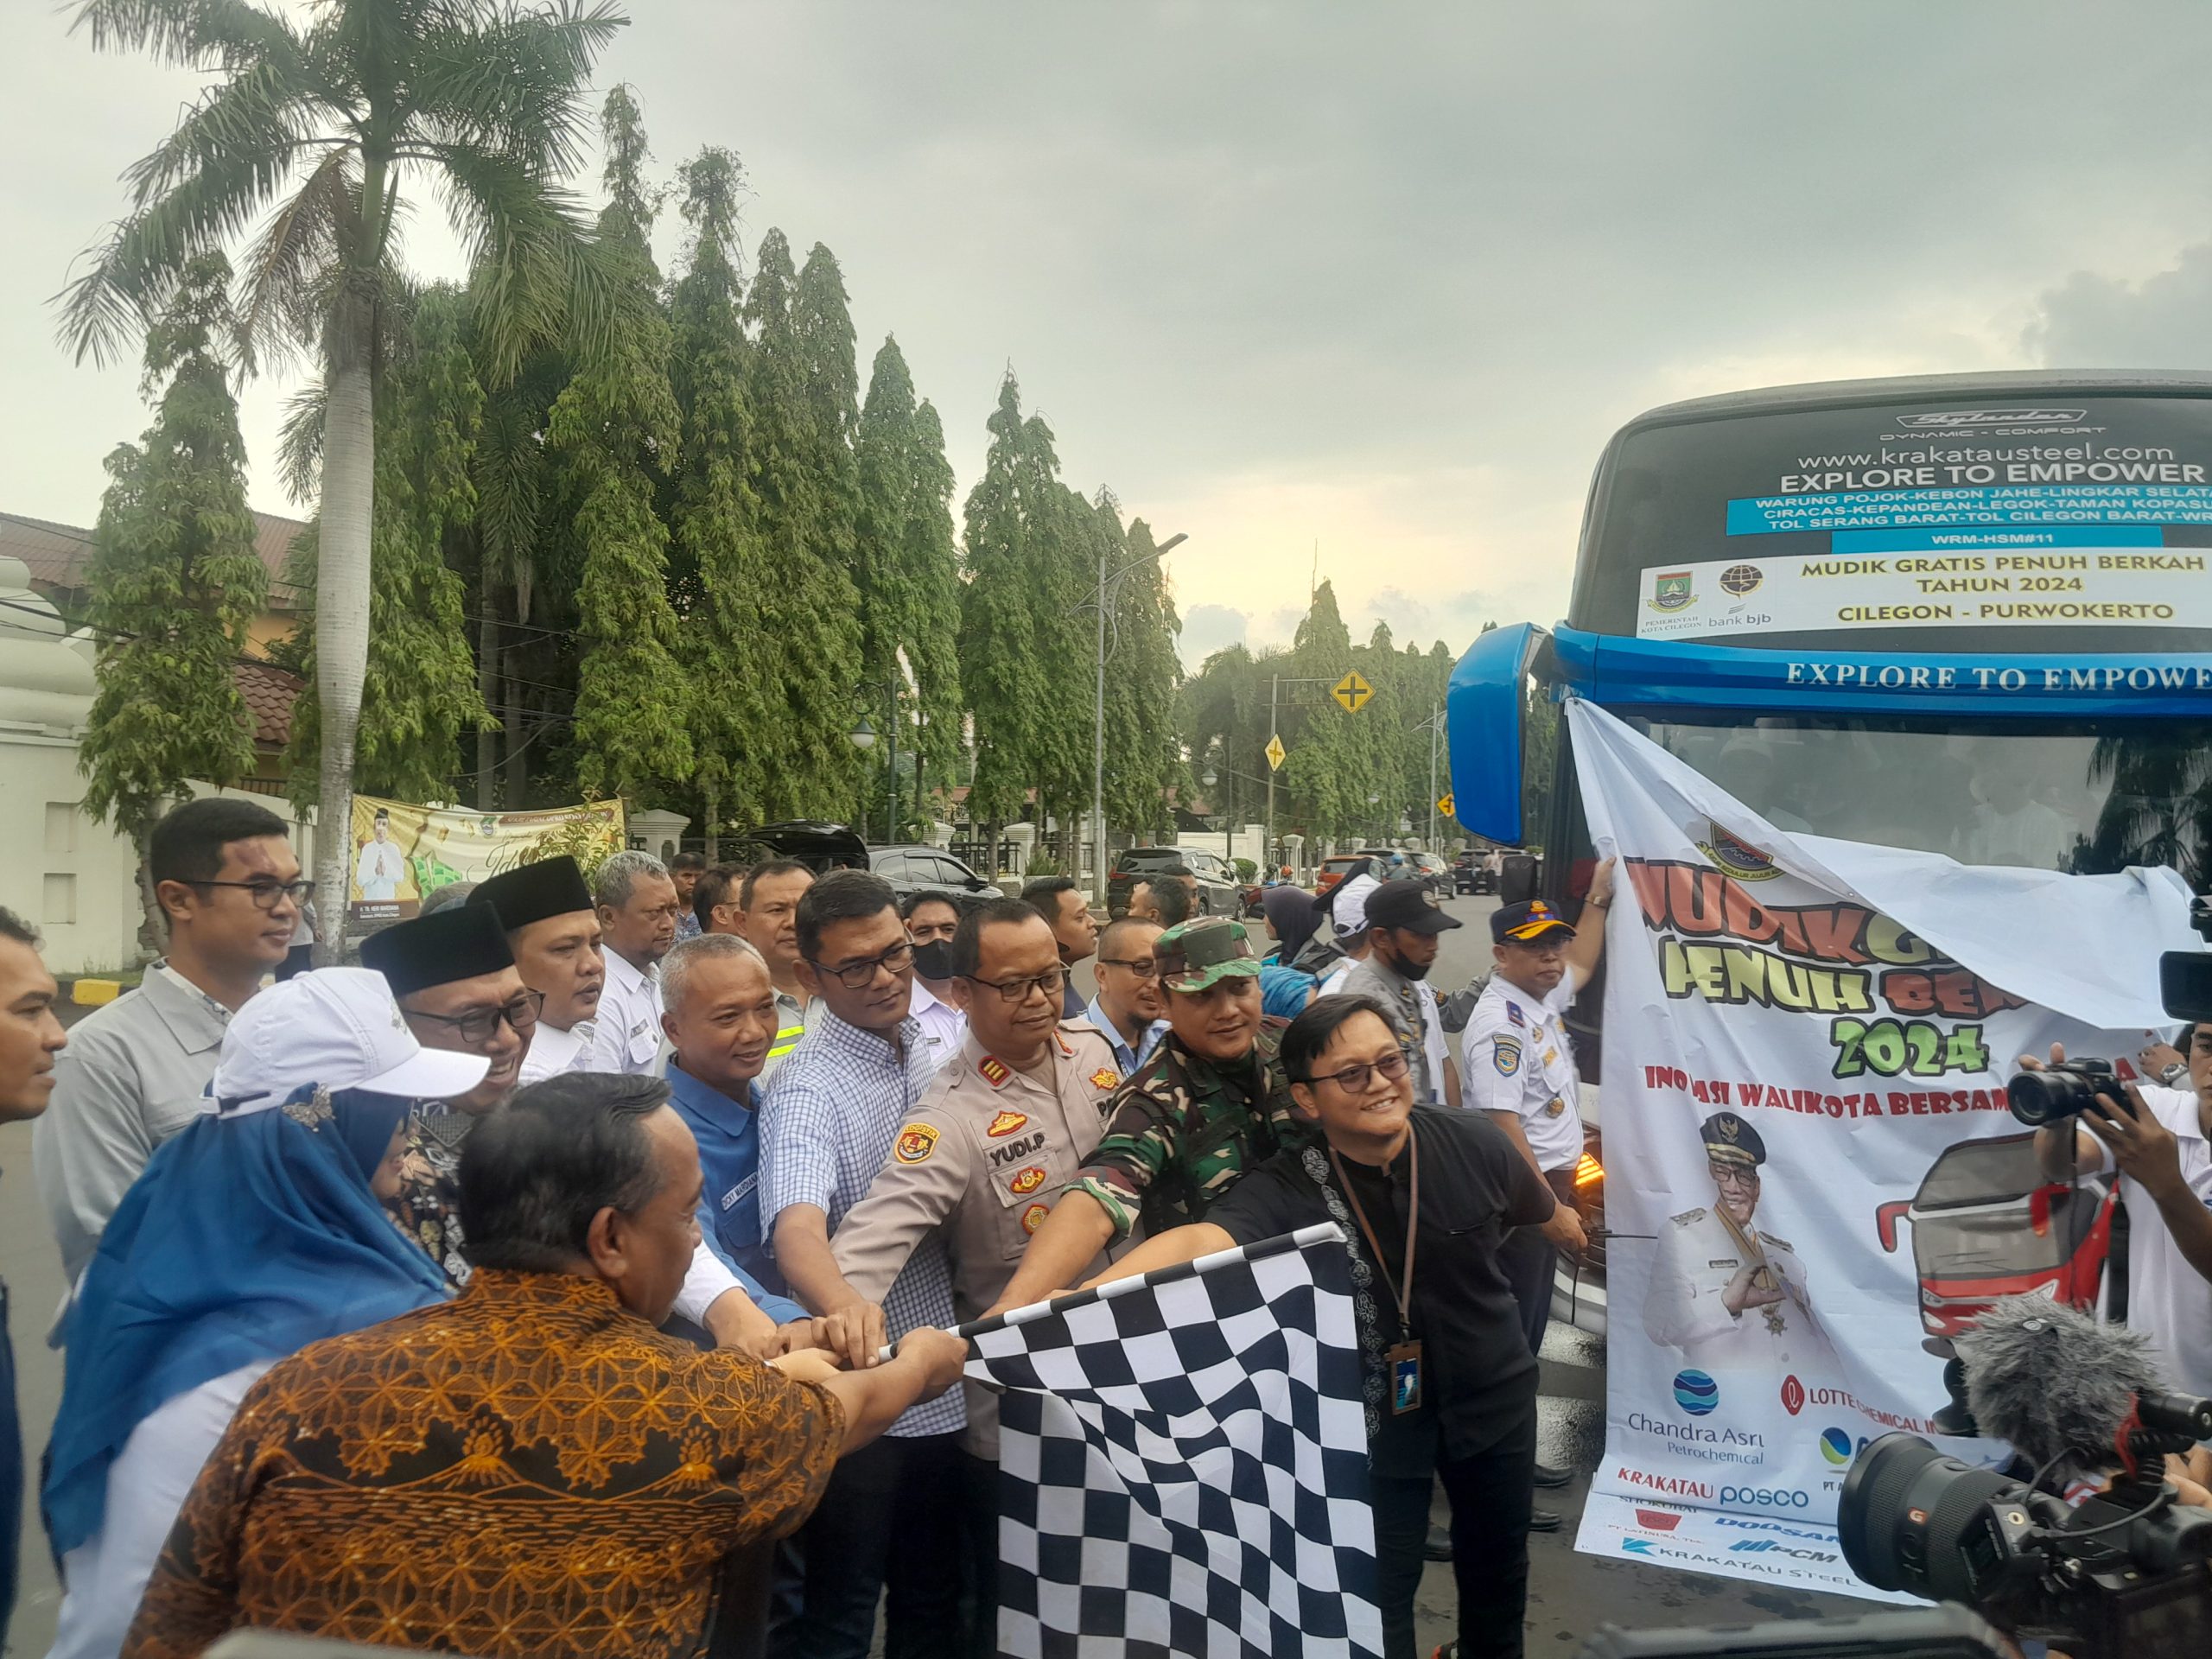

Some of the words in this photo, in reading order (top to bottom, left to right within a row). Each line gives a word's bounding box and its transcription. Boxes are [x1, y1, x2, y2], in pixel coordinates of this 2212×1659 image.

[1879, 430, 1974, 441] DYNAMIC
[1994, 427, 2107, 436] COMFORT
[1797, 442, 2174, 468] www.krakatausteel.com
[1781, 467, 1936, 493] EXPLORE
[1943, 464, 1996, 484] TO
[2006, 462, 2206, 483] EMPOWER
[1756, 495, 1838, 508] WARUNG
[1843, 490, 1983, 503] POJOK-KEBON
[1989, 487, 2139, 499] JAHE-LINGKAR
[1764, 499, 2126, 519] CIRACAS-KEPANDEAN-LEGOK-TAMAN
[1769, 520, 1804, 530] TOL
[1809, 516, 1888, 528] SERANG
[1894, 512, 2004, 524] BARAT-TOL
[2010, 511, 2101, 522] CILEGON
[1931, 534, 2054, 544] WRM-HSM#11
[1802, 560, 1888, 577] MUDIK
[1895, 557, 1986, 573] GRATIS
[1995, 556, 2088, 571] PENUH
[2098, 556, 2204, 570] BERKAH
[1916, 578, 2011, 594] TAHUN
[2018, 577, 2083, 592] 2024
[1708, 616, 1743, 627] bank
[1746, 613, 1771, 625] bjb
[1838, 606, 1953, 621] CILEGON
[1980, 604, 2175, 620] PURWOKERTO
[1787, 663, 1956, 688] EXPLORE
[1973, 667, 2025, 690] TO
[1831, 1017, 1990, 1079] 2024
[1737, 1083, 1884, 1118] WALIKOTA
[990, 1132, 1045, 1166] YUDI.P
[1809, 1388, 1856, 1409] LOTTE
[1628, 1413, 1719, 1444] Chandra
[1721, 1428, 1765, 1448] Asri
[1668, 1441, 1764, 1465] Petrochemical
[1618, 1467, 1714, 1499] KRAKATAU
[1659, 1548, 1782, 1574] KRAKATAU
[1789, 1569, 1859, 1587] STEEL
